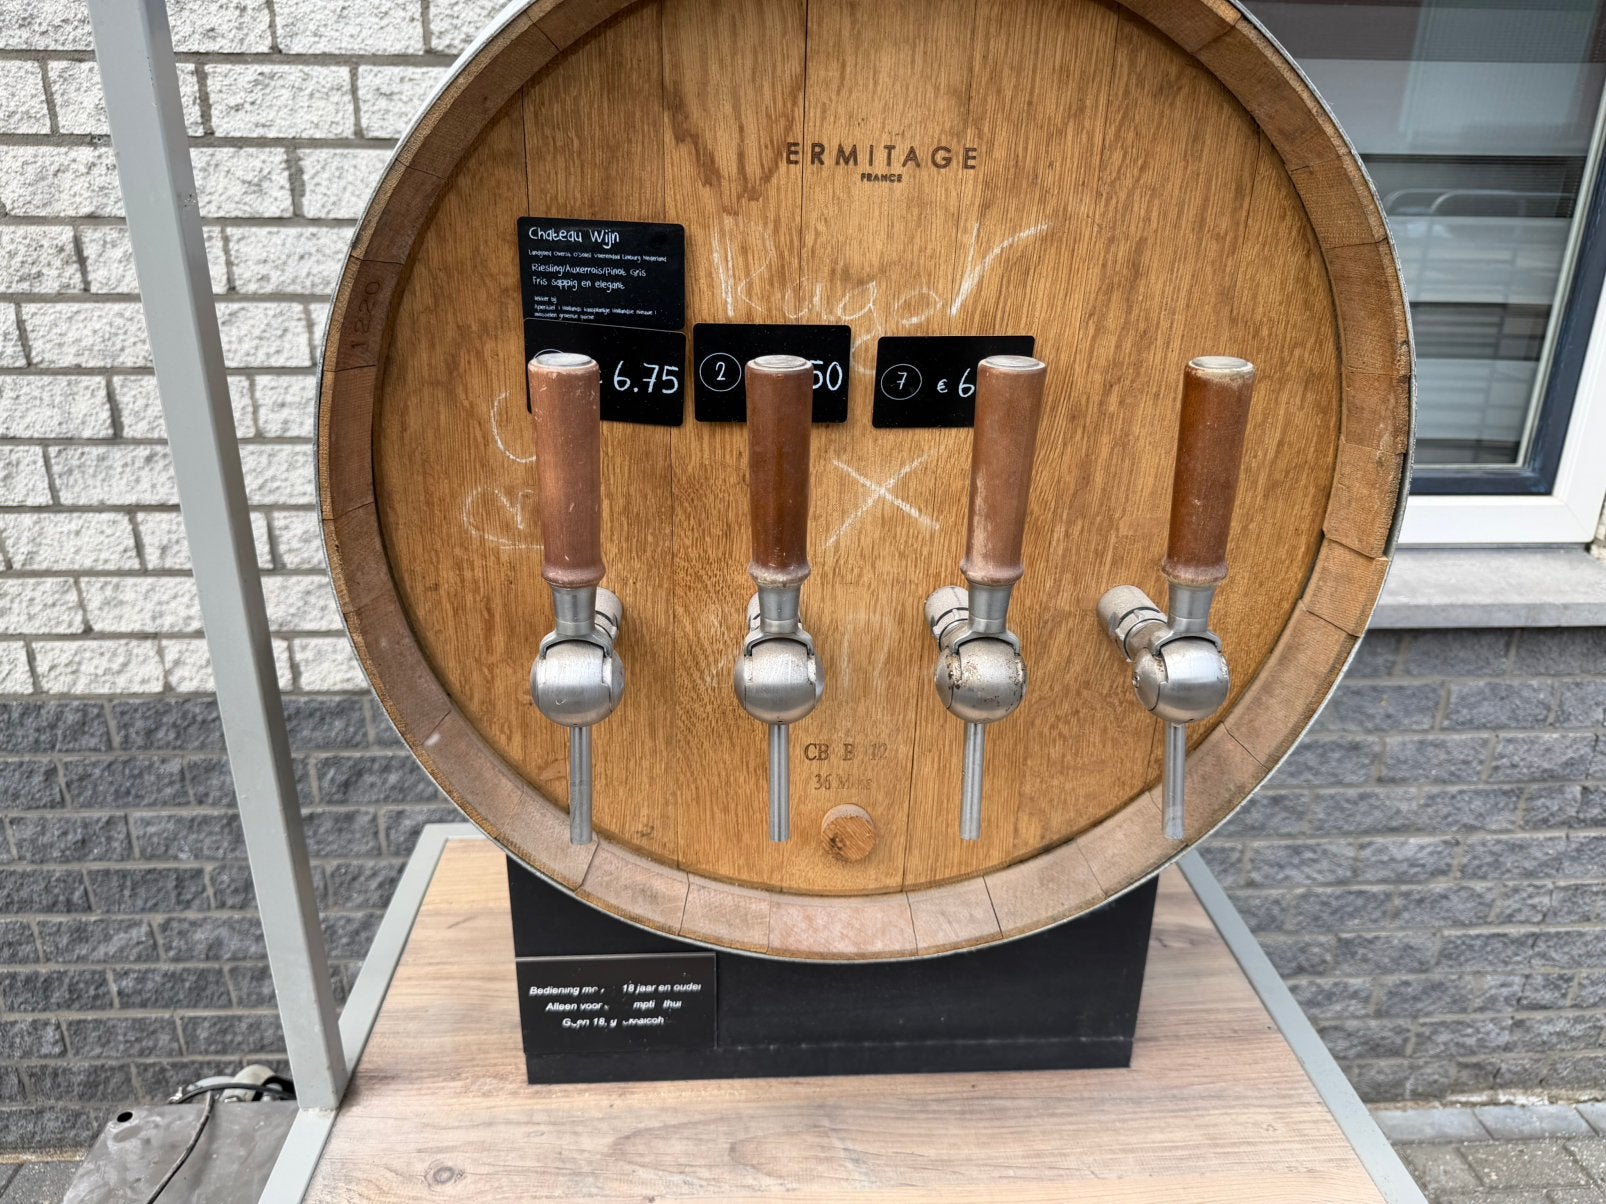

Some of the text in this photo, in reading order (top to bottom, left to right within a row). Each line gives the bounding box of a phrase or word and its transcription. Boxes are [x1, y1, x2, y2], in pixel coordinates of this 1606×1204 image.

[785, 142, 978, 170] ERMITAGE
[860, 172, 903, 183] FRANCE
[528, 226, 620, 249] Chateau Wijn
[622, 254, 642, 263] Limburg
[630, 268, 647, 277] Gris
[532, 276, 626, 293] Fris sappig en elegant
[613, 360, 679, 394] 6.75
[715, 362, 726, 381] 2
[896, 371, 908, 390] 7
[528, 985, 579, 998] Bediening
[622, 983, 635, 994] 18
[635, 983, 656, 996] jaar
[658, 984, 671, 993] en
[544, 1001, 577, 1012] Alleen
[580, 1002, 602, 1011] voor
